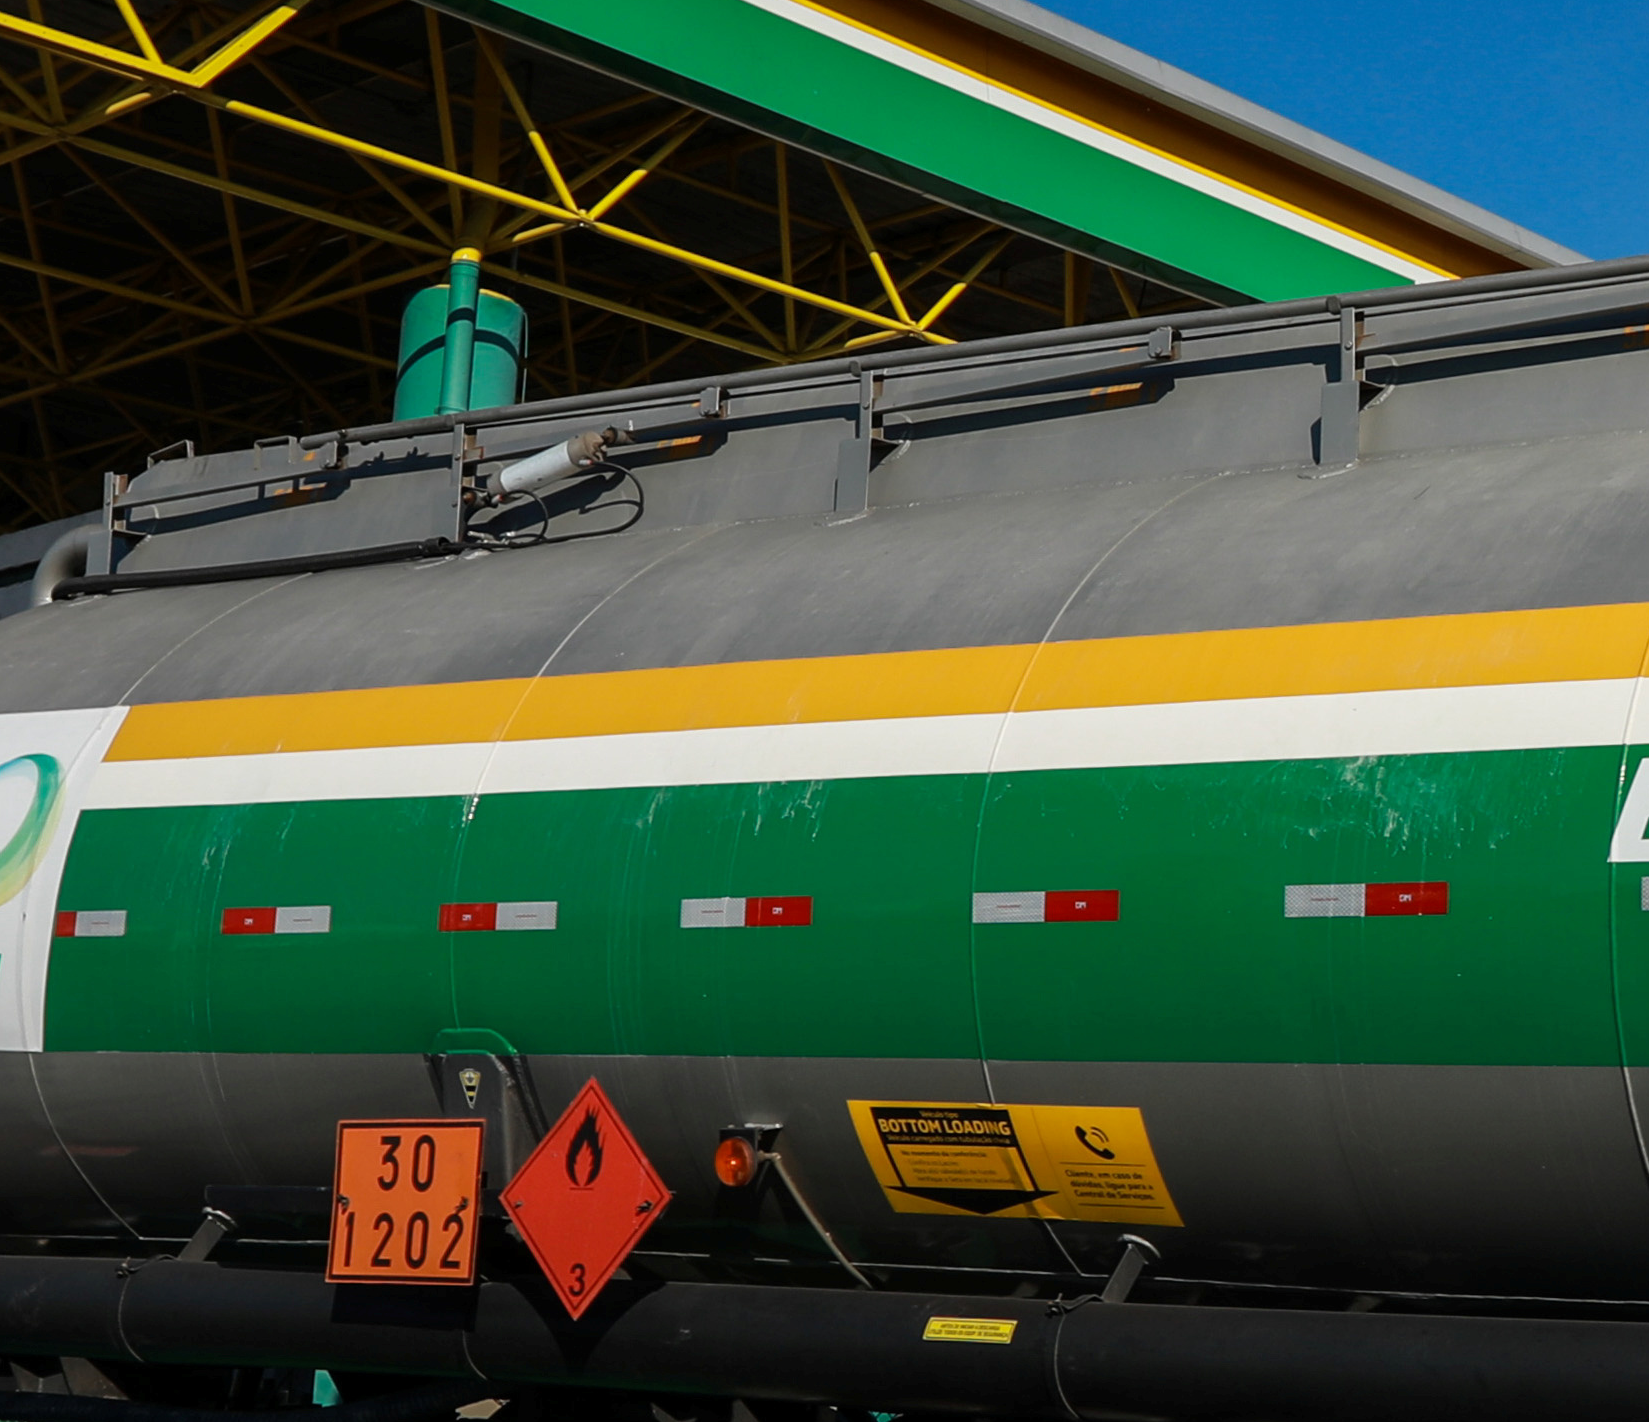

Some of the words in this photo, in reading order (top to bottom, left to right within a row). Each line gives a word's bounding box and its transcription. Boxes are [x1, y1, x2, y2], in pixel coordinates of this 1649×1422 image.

[878, 1118, 942, 1134] BOTTOM
[943, 1119, 1012, 1136] LOADING
[377, 1134, 436, 1192] 30
[344, 1211, 465, 1270] 1202
[568, 1263, 586, 1297] 3
